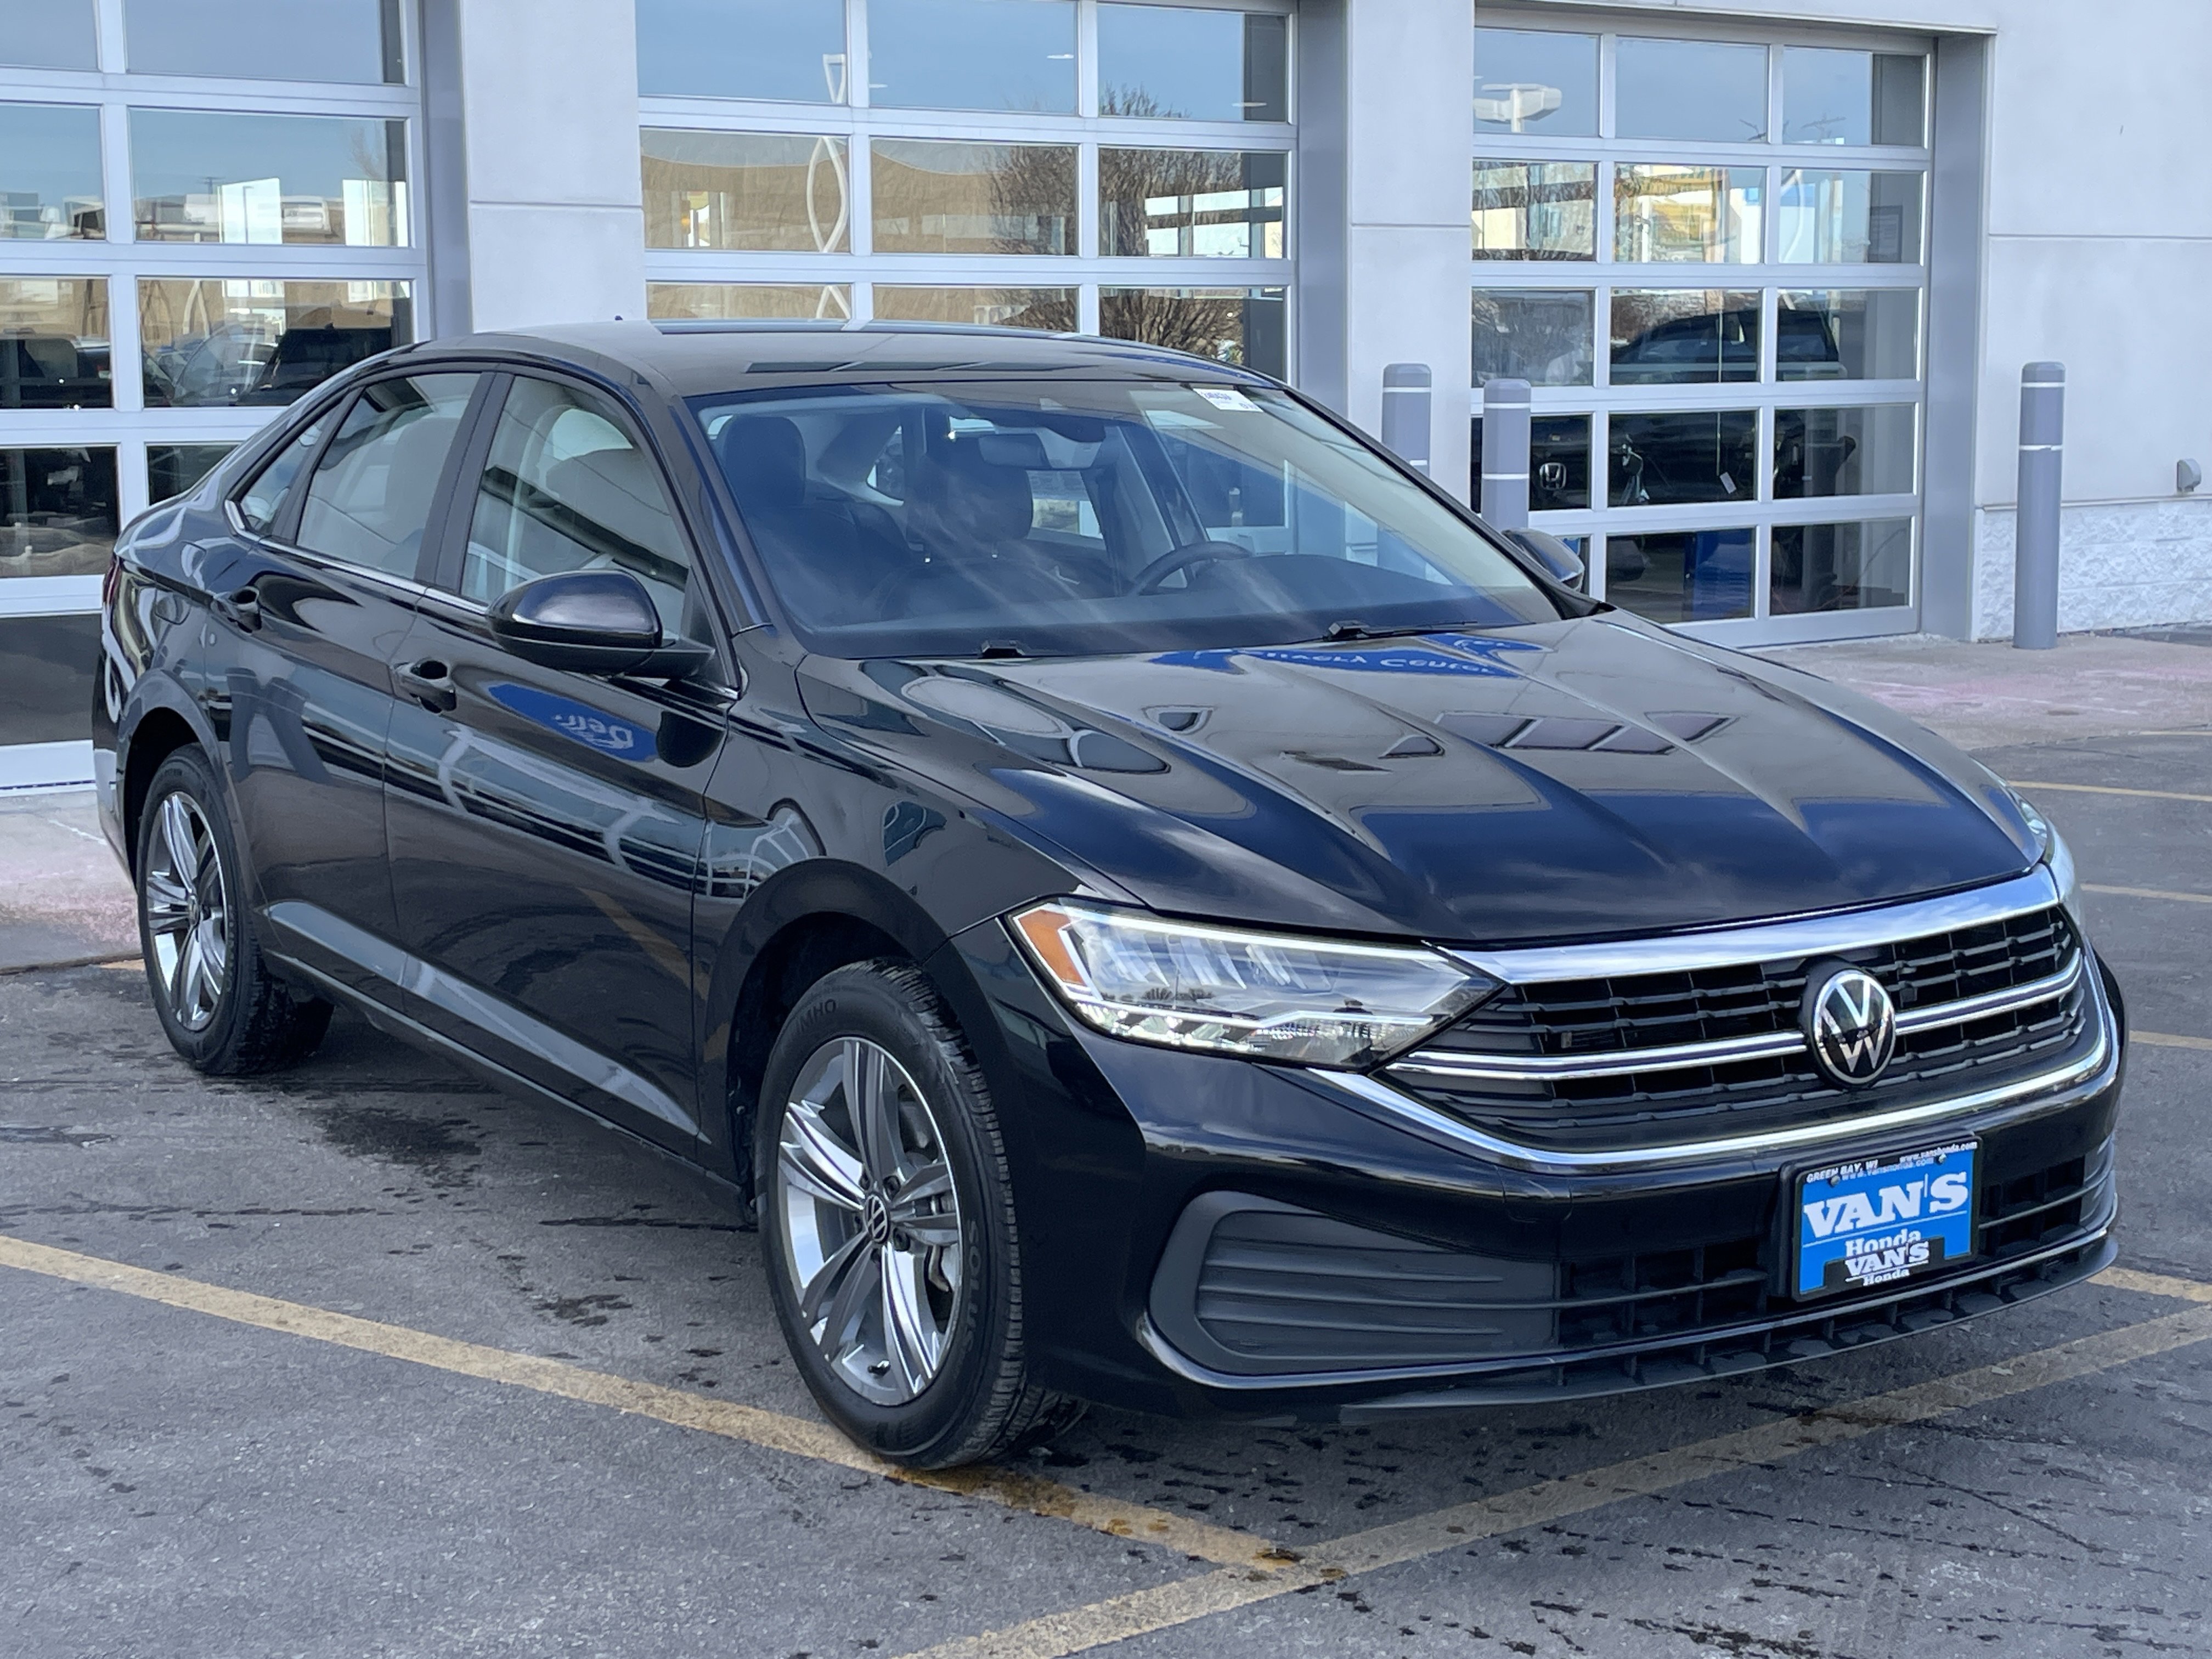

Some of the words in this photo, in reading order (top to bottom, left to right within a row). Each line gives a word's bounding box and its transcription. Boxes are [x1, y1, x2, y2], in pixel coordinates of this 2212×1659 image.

[1806, 1167, 1839, 1183] GREEN
[1803, 1171, 1968, 1238] VAN'S
[1845, 1228, 1921, 1257] Honda
[1844, 1240, 1930, 1277] VAN'S
[1863, 1268, 1910, 1286] Honda
